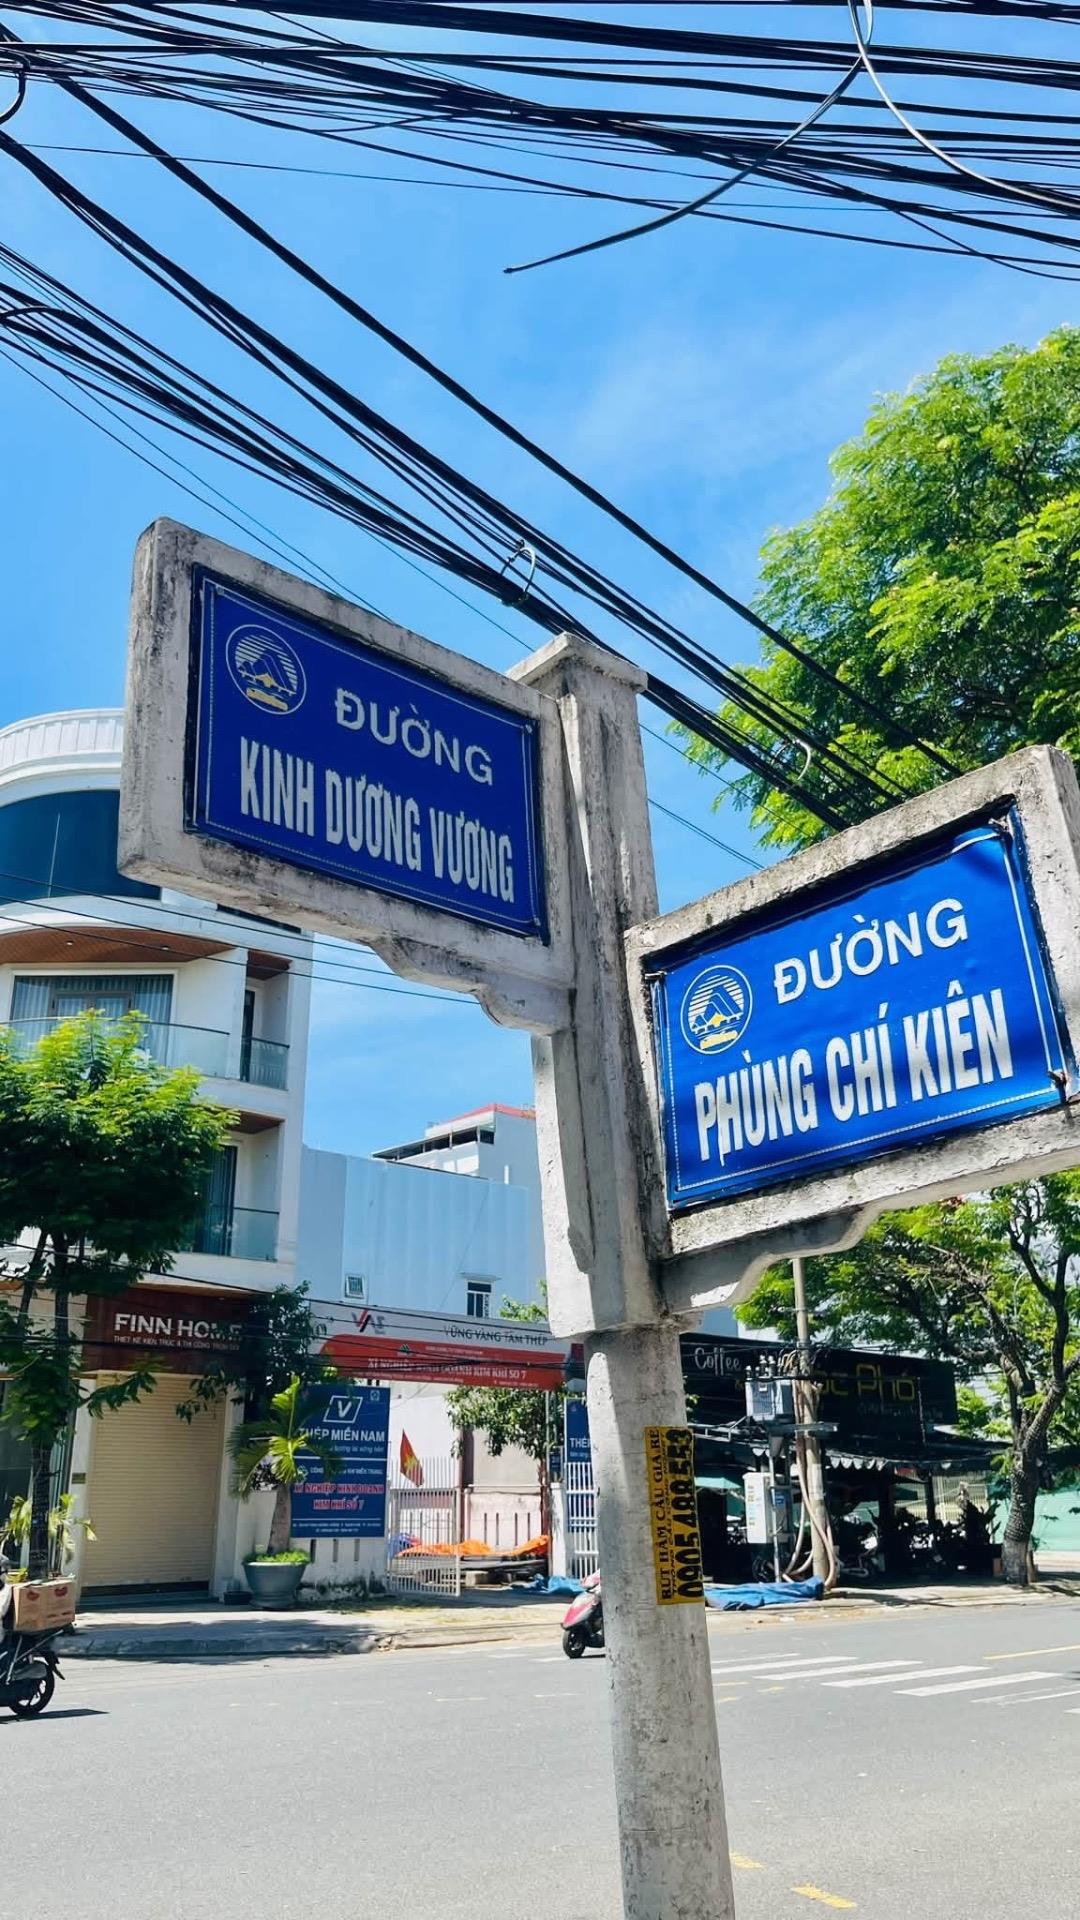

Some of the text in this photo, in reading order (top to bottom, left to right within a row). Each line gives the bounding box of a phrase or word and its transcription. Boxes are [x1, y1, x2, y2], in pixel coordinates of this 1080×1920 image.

[335, 687, 493, 786] ĐƯỜNG
[240, 736, 515, 903] KINH DƯƠNG VƯƠNG
[773, 898, 969, 1004] ĐƯỜNG
[694, 981, 1014, 1167] PHÙNG CHÍ KIÊN
[114, 1313, 172, 1335] FINN
[694, 1347, 741, 1376] Coffee
[360, 1430, 385, 1442] NAM
[569, 1435, 591, 1449] THÉ
[665, 1429, 704, 1598] 0905 488 553
